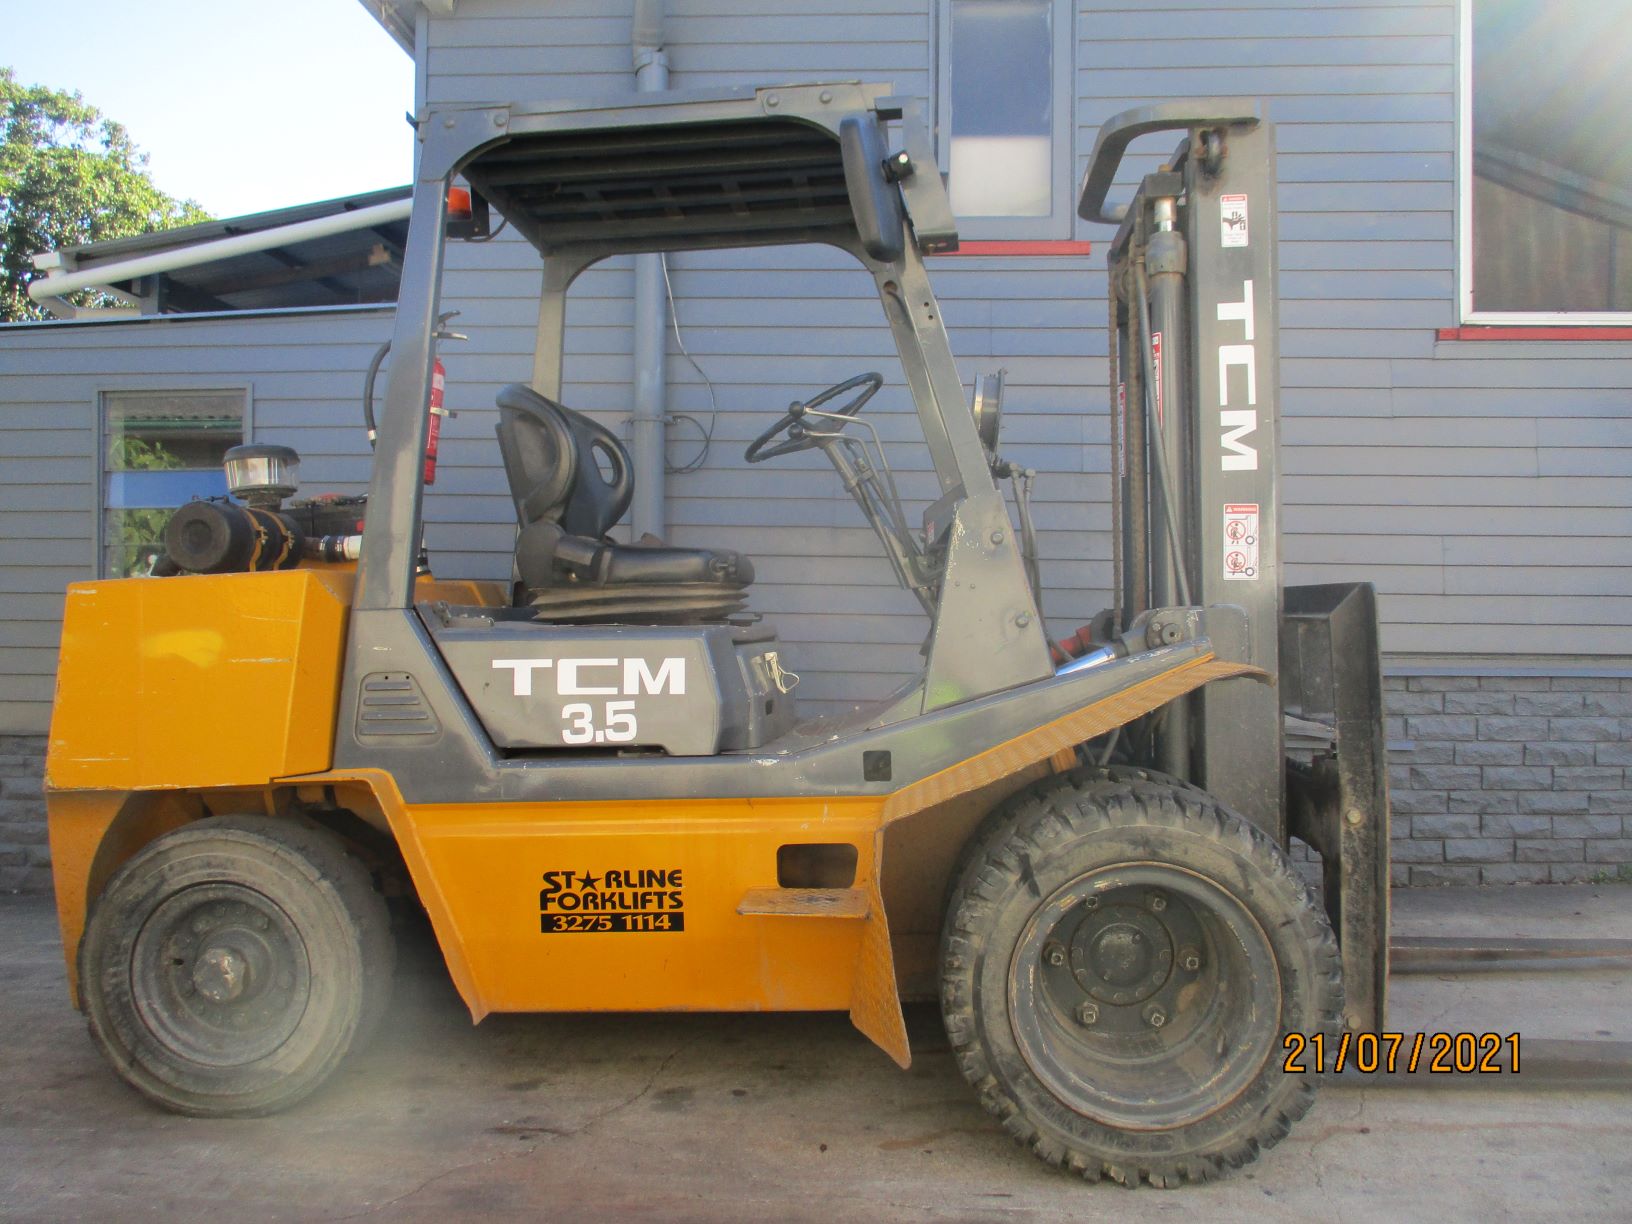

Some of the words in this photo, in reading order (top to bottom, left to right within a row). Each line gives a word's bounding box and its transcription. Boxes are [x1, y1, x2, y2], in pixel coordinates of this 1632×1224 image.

[1217, 280, 1258, 471] TCM
[492, 658, 686, 696] TCM
[562, 701, 638, 744] 3.5
[540, 890, 684, 911] FORKLIFTS
[553, 915, 613, 931] 3275
[622, 914, 672, 930] 1114
